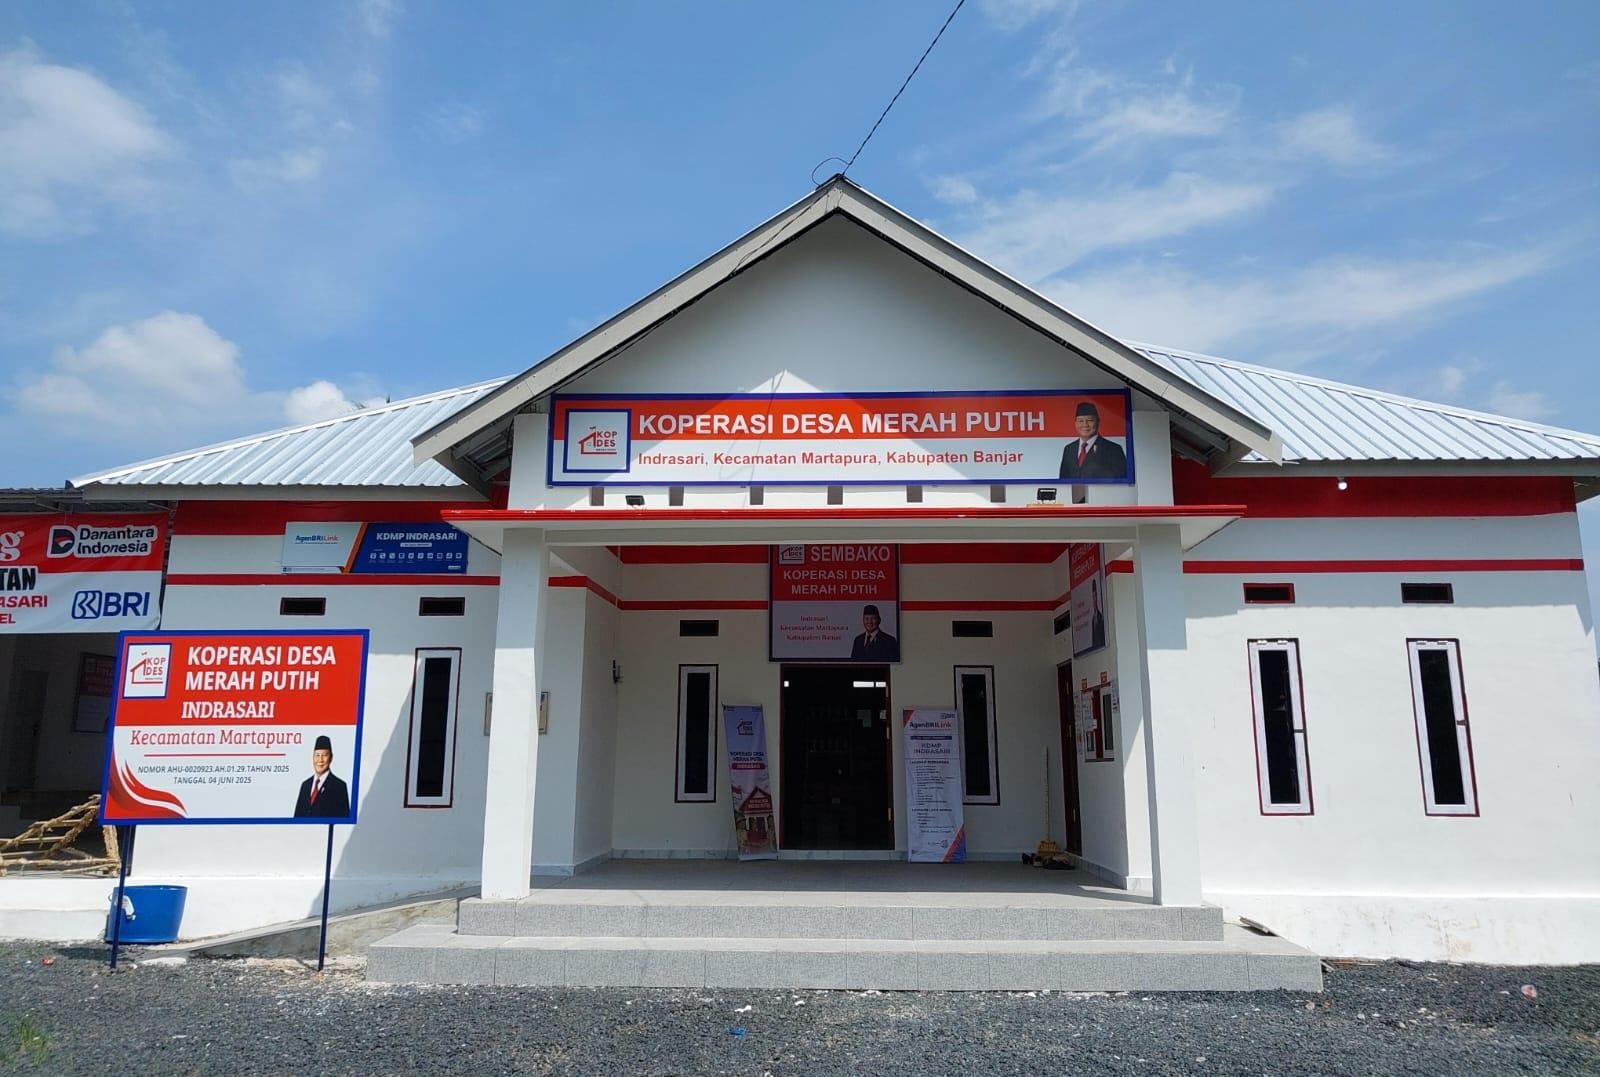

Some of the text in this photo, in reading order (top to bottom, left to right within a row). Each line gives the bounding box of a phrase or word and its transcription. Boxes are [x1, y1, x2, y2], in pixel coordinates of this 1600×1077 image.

[638, 410, 1045, 435] KOPERASI DESA MERAH PUTIH
[596, 431, 618, 439] KOP
[596, 439, 616, 447] DES
[638, 450, 1024, 467] Indrasari, Kecamatan Martapura, Kabupaten Banjar
[79, 527, 155, 541] Danantara
[376, 532, 458, 541] KDMP INDRASARI
[77, 540, 149, 555] Indonesia
[811, 546, 890, 561] SEMBAKO
[783, 570, 886, 580] KOPERASI DESA
[791, 584, 877, 594] MERAH PUTIH
[103, 592, 150, 617] BRI
[146, 657, 166, 666] KOP
[187, 645, 336, 666] KOPERASI DESA
[146, 666, 164, 676] DES
[185, 670, 320, 691] MERAH PUTIH
[181, 701, 276, 719] INDRASARI
[130, 729, 302, 749] Kecamatan Martapura
[138, 766, 166, 774] NOMOR
[273, 765, 290, 773] 2025
[173, 776, 252, 786] TANGGAL 04 JUNI 2025
